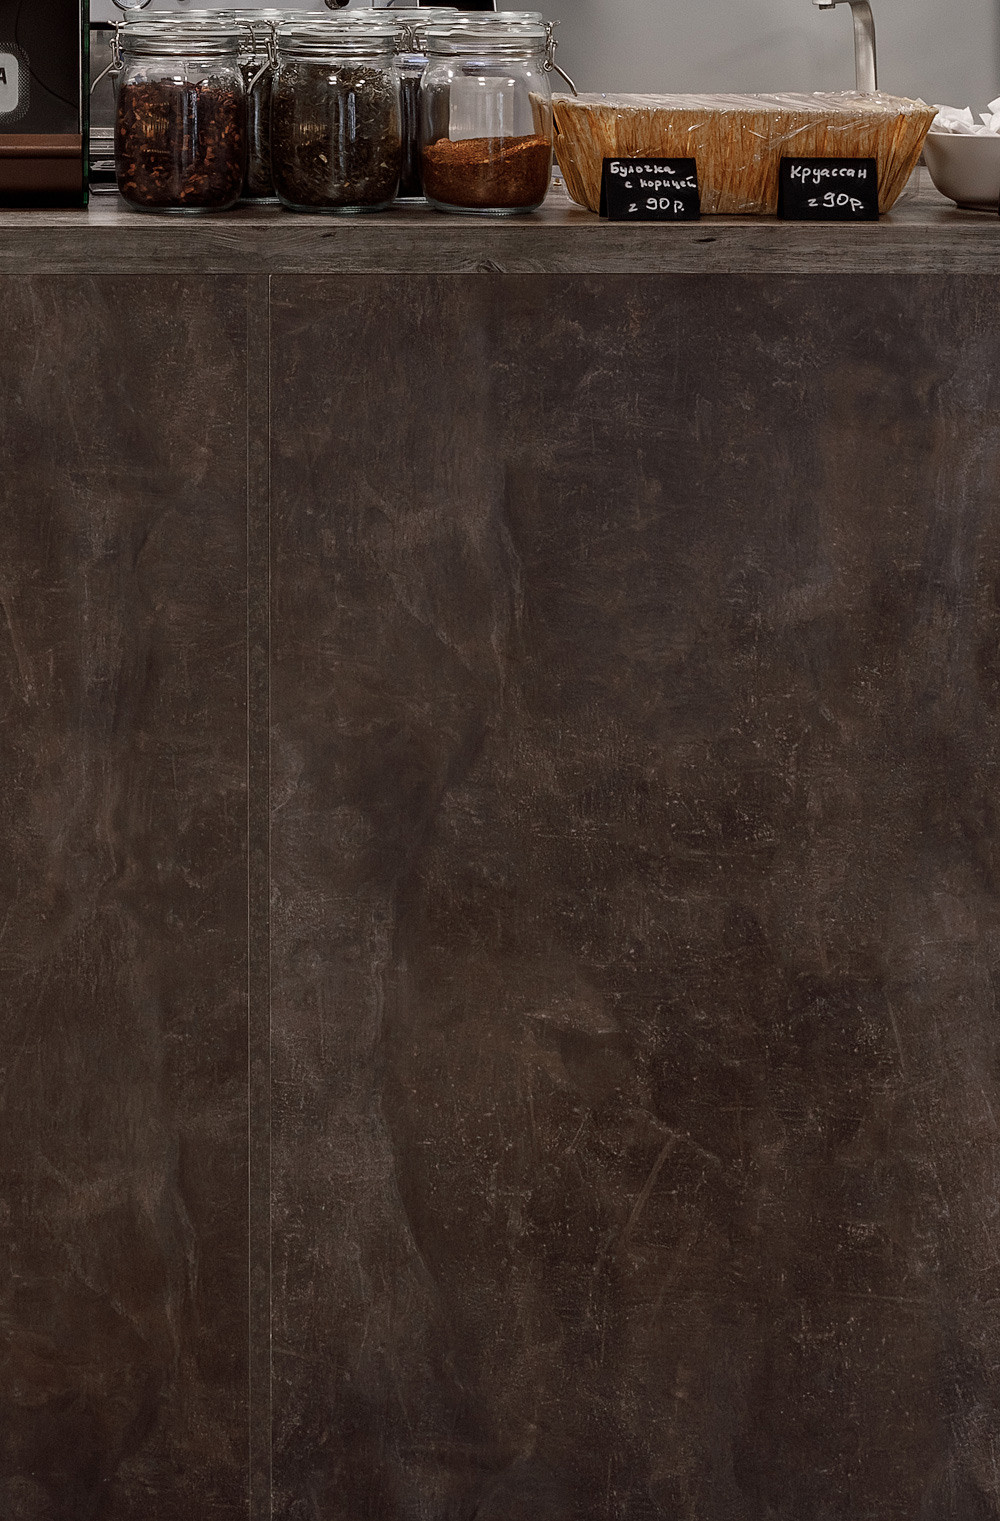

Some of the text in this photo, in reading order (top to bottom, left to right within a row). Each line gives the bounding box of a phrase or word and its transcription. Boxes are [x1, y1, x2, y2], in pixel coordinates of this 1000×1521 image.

[610, 161, 676, 177] Булочка
[790, 165, 867, 184] Круассан
[640, 176, 697, 191] корицей
